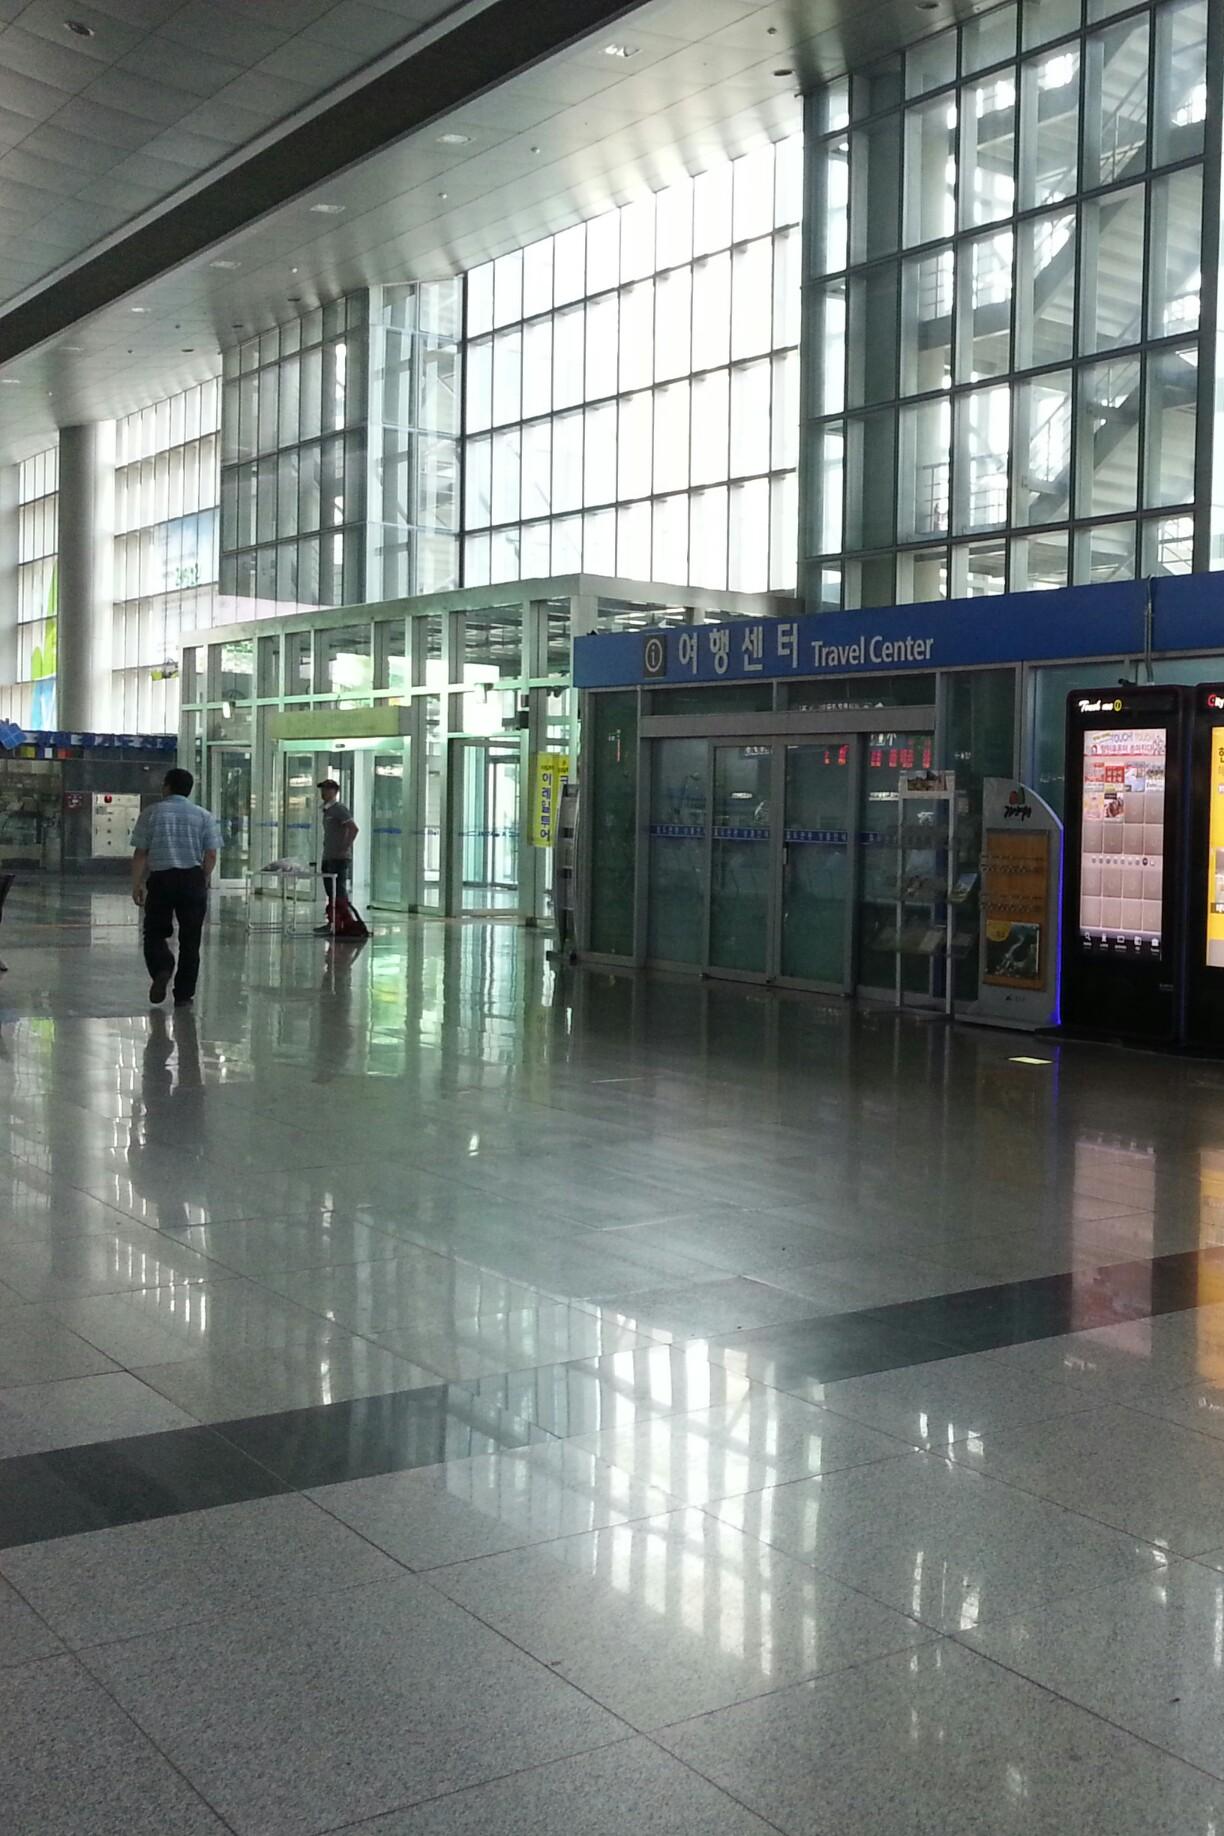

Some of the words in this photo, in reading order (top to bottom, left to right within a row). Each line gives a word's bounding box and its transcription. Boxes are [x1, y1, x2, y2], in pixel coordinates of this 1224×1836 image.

[678, 622, 798, 675] 여행센터
[811, 636, 865, 667] Travel
[869, 635, 934, 664] Center
